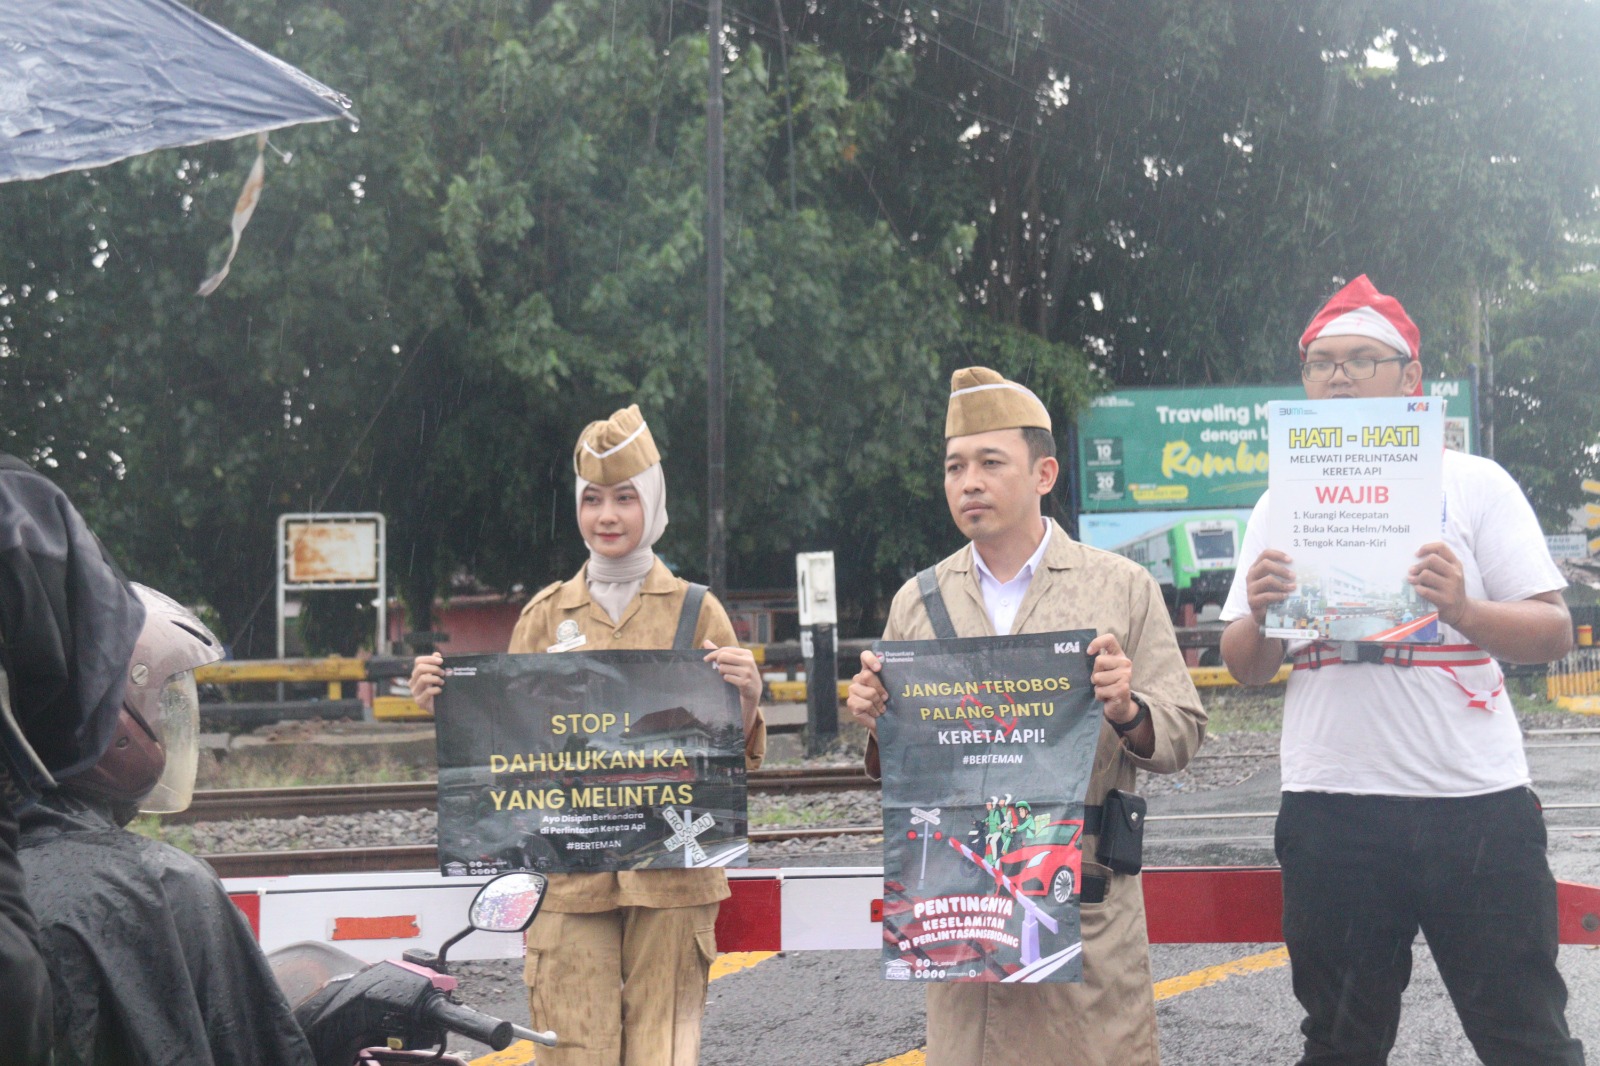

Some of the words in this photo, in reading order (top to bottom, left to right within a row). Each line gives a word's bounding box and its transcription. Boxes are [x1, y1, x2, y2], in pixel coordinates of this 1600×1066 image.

[1156, 404, 1249, 426] Traveling
[1254, 403, 1268, 420] M
[1407, 402, 1429, 412] KAI
[1200, 428, 1258, 445] dengan
[1289, 427, 1342, 449] HATI
[1361, 425, 1420, 447] HATI
[1096, 444, 1112, 458] 10
[1161, 440, 1268, 479] Rombo
[1290, 454, 1342, 463] MELEWATI
[1345, 453, 1418, 463] PERLINTASAN
[1322, 467, 1362, 476] KERETA
[1363, 467, 1382, 476] API
[1097, 476, 1114, 489] 20
[1315, 486, 1389, 504] WAJIB
[1293, 511, 1301, 519] 1.
[1303, 511, 1336, 520] Kurangi
[1339, 511, 1389, 520] Kecepatan
[1293, 525, 1301, 533] 2.
[1303, 525, 1324, 533] Buka
[1327, 525, 1349, 533] Kaca
[1351, 525, 1410, 534] Helm/Mobil
[1293, 539, 1301, 547] 3.
[1303, 538, 1333, 548] Tengok
[1336, 538, 1386, 547] Kanan-Kiri
[1054, 641, 1080, 654] KAI
[902, 682, 979, 698] JANGAN
[982, 677, 1071, 694] TEROBOS
[920, 705, 995, 721] PALANG
[999, 702, 1054, 718] PINTU
[551, 713, 617, 735] STOP
[624, 712, 631, 733] !
[938, 729, 1006, 745] KERETA
[1010, 728, 1046, 744] API!
[490, 750, 645, 774] DAHULUKAN
[653, 749, 689, 768] KA
[962, 753, 1023, 765] #BERTEMAN
[490, 789, 565, 811] YANG
[571, 784, 693, 809] MELINTAS
[542, 815, 560, 825] Ayo
[561, 814, 592, 824] Disiplin
[593, 812, 644, 822] Berkendara
[540, 825, 550, 834] di
[551, 824, 599, 834] Perlintasan
[601, 824, 630, 833] Kereta
[631, 823, 646, 832] Api
[665, 810, 704, 861] CROSSING
[566, 840, 622, 851] #BERTEMAN
[914, 896, 1013, 918] PENTINGNYA
[898, 939, 911, 951] DI
[913, 929, 984, 946] PERLINTASAN
